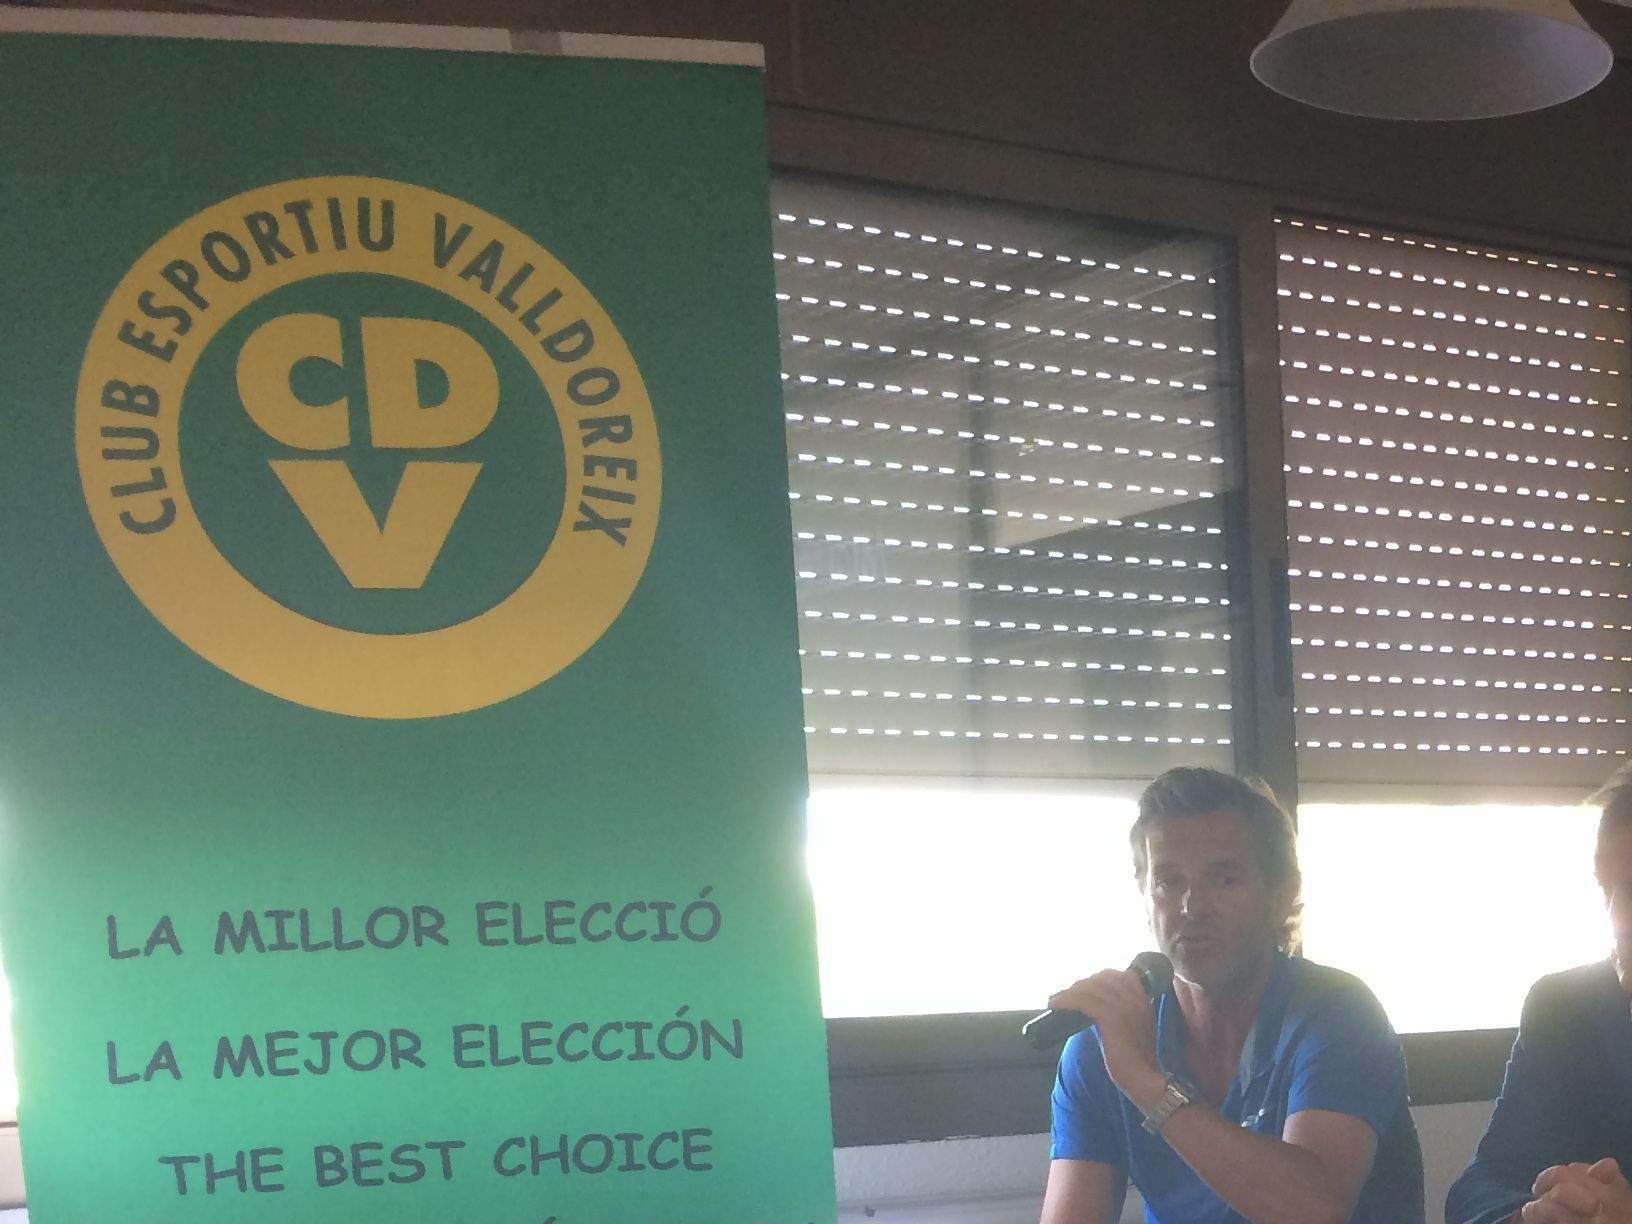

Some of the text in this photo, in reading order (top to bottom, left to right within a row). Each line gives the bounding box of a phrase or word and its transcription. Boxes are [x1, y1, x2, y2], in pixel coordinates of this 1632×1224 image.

[101, 197, 637, 548] CLUB ESPORTIU VALLDOREIX
[235, 312, 501, 451] CD
[107, 886, 722, 960] LA MILLOR ELECCIÓ
[106, 1005, 744, 1086] LA MEJOR ELECCIÓN
[159, 1128, 714, 1196] THE BEST CHOICE
